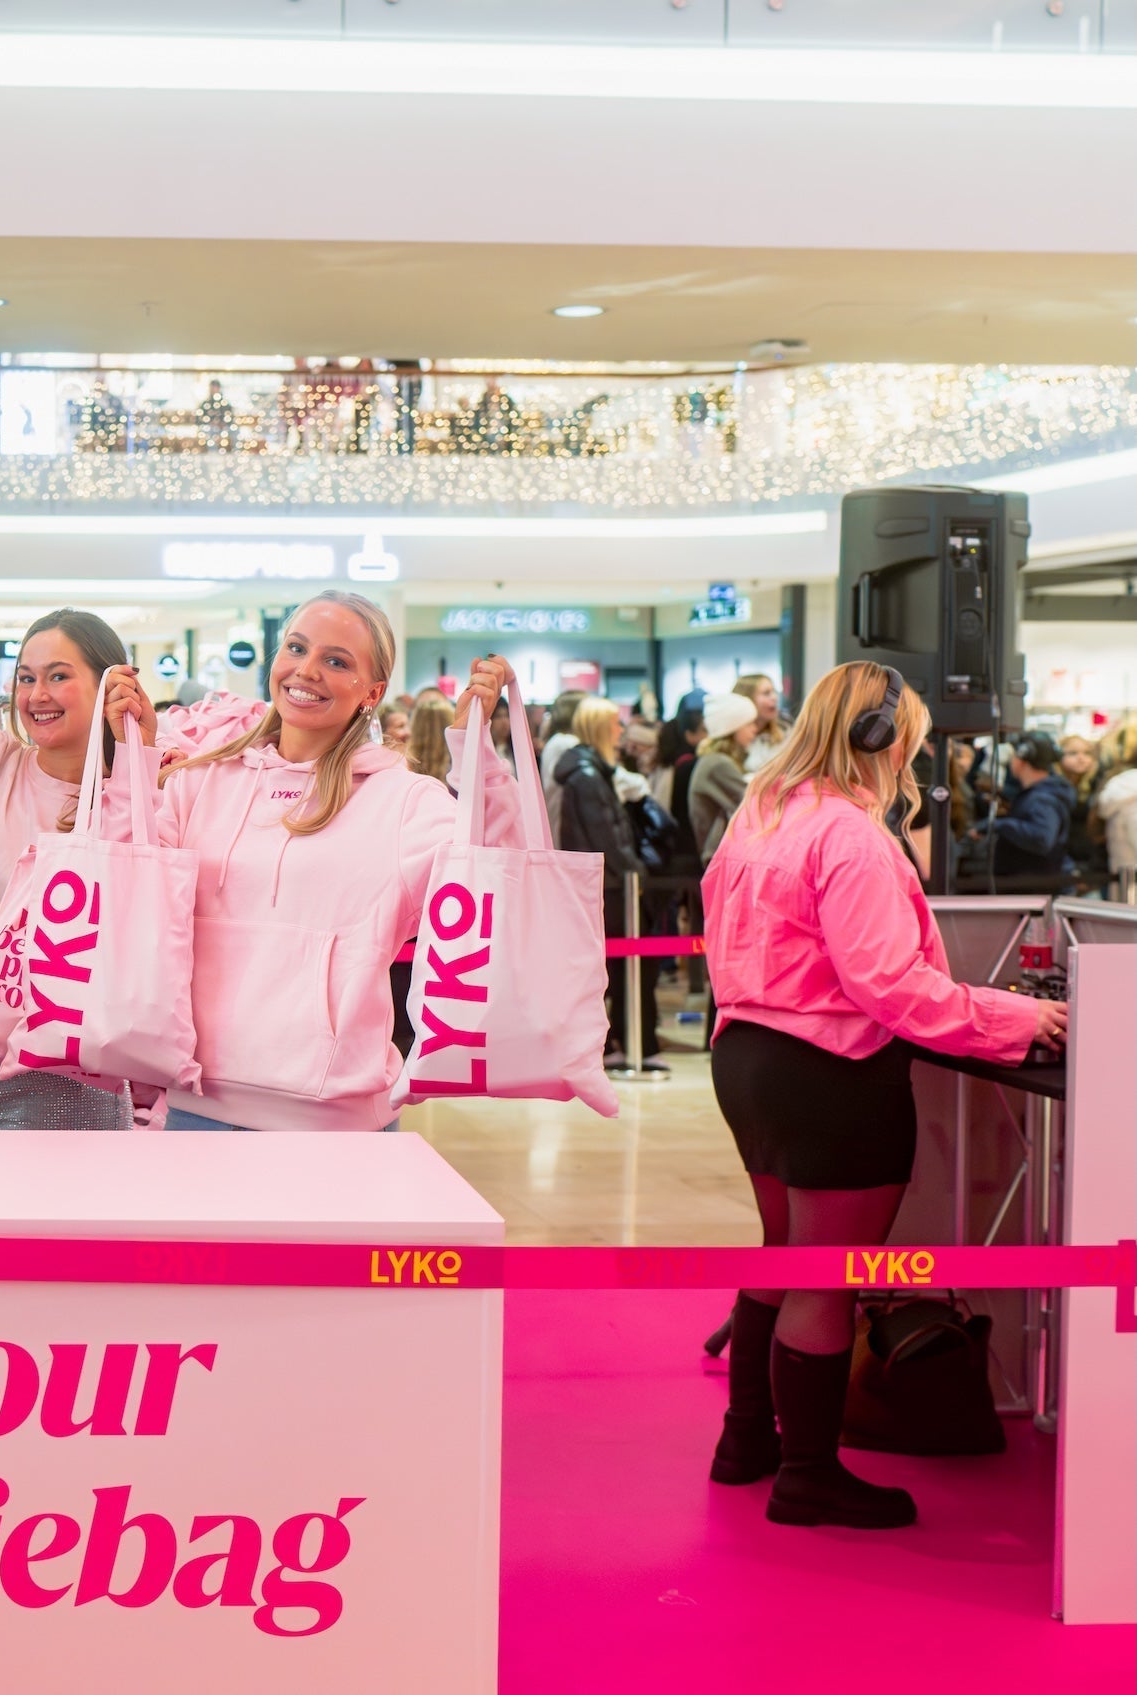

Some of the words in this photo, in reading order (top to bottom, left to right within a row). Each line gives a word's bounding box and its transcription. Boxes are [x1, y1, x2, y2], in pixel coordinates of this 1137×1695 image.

[271, 790, 302, 799] LYKO
[19, 869, 100, 1069] LYKO
[408, 882, 494, 1095] LYKO
[371, 1250, 462, 1284] LYKO
[845, 1250, 935, 1284] LYKO
